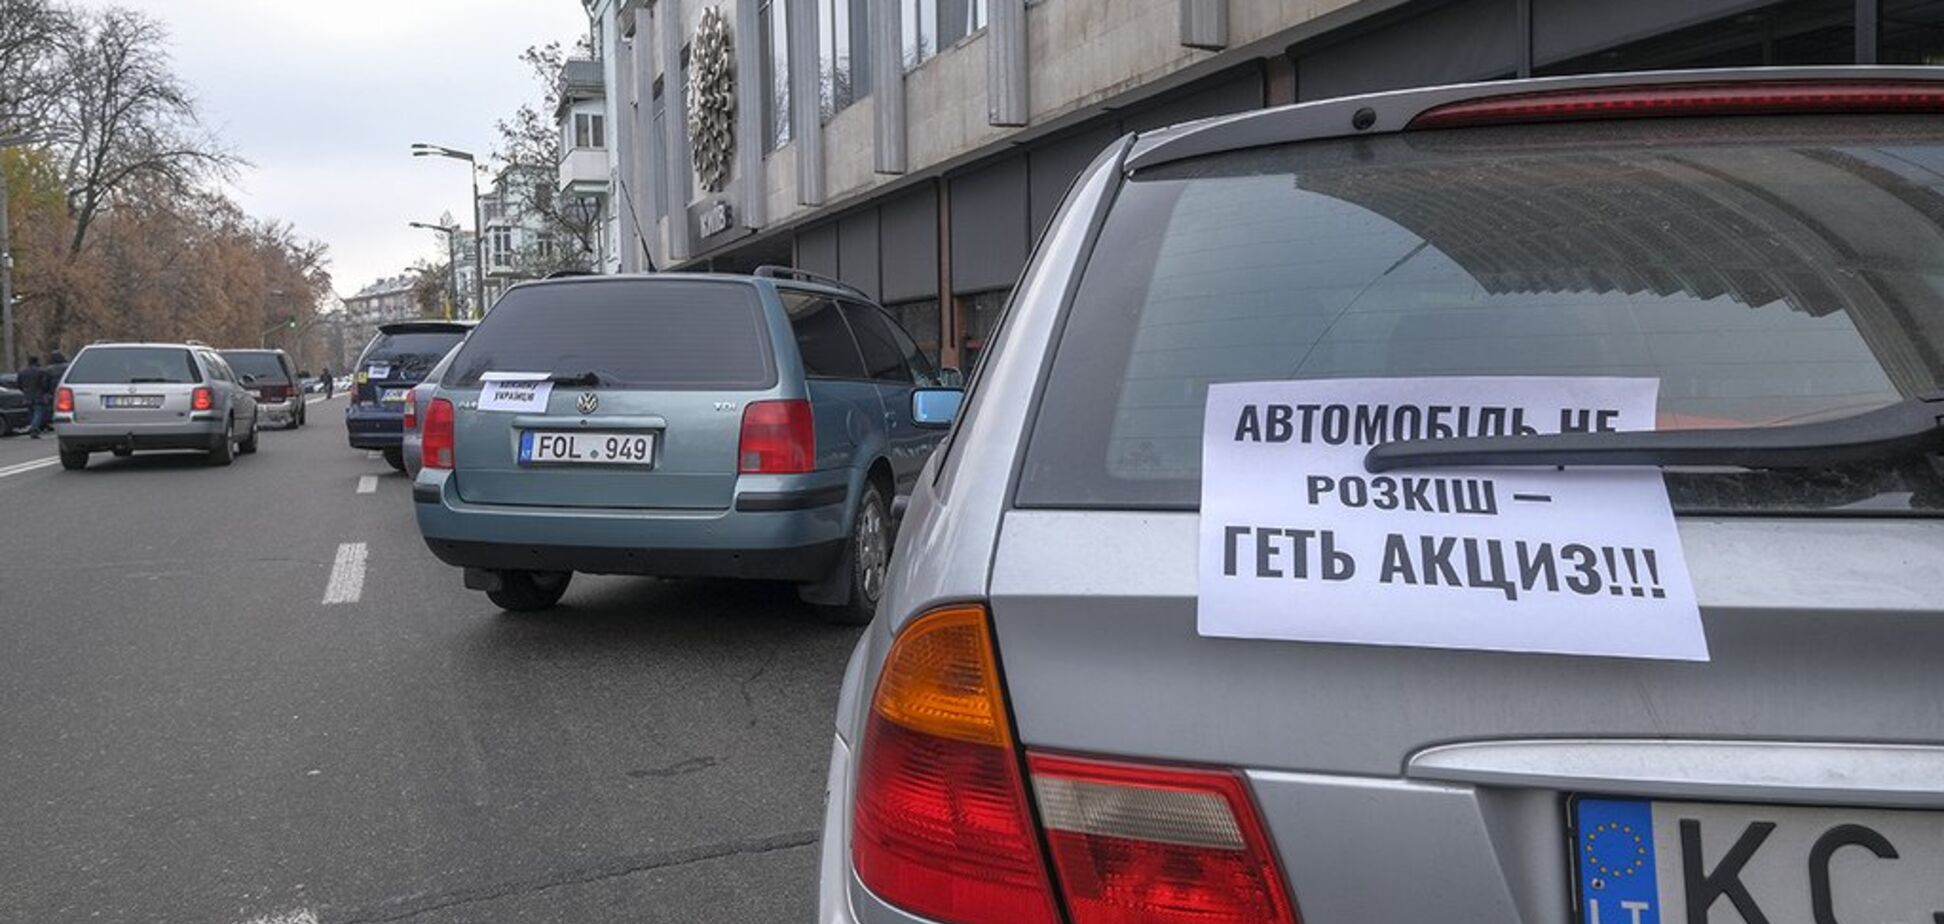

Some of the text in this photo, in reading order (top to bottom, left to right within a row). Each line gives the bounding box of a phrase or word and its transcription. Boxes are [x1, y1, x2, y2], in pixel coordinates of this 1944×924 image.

[538, 436, 647, 461] FOL 949
[1307, 475, 1499, 515] РОЗКІШ
[1223, 526, 1666, 601] ГЕТЬ АКЦИЗ!!!
[1680, 818, 1944, 924] KC
